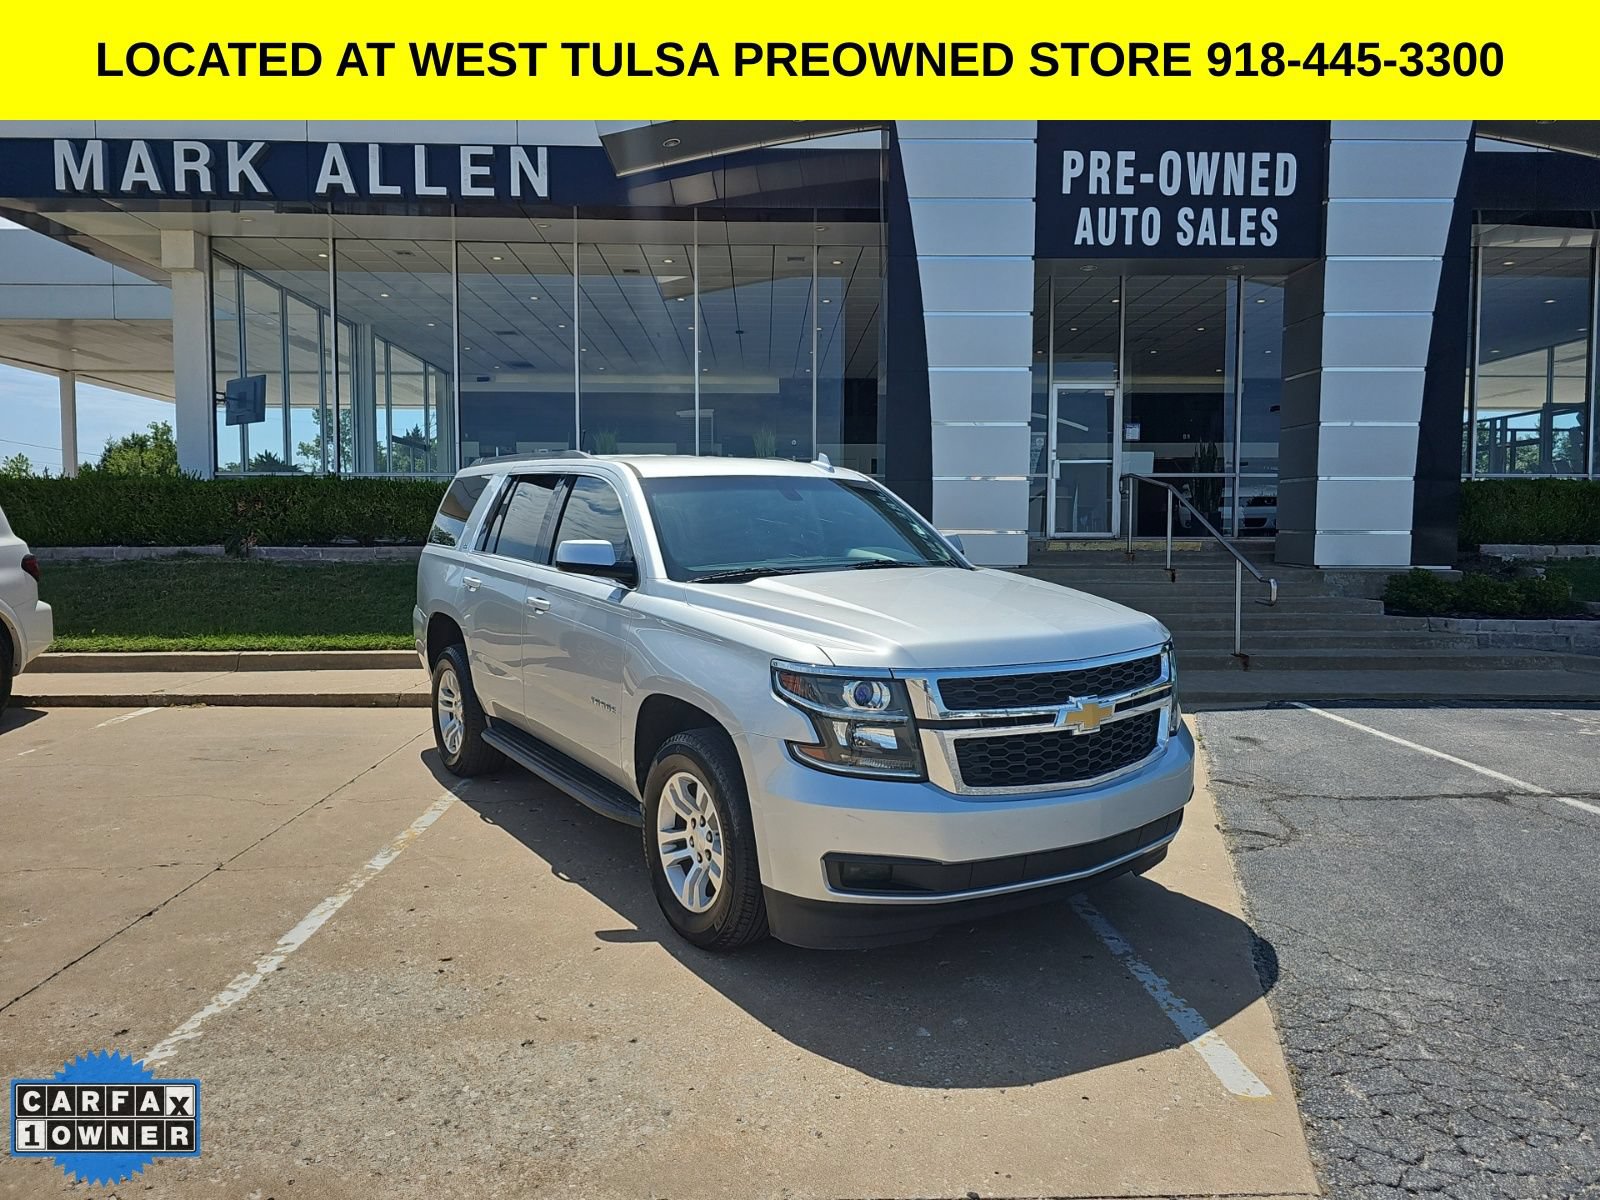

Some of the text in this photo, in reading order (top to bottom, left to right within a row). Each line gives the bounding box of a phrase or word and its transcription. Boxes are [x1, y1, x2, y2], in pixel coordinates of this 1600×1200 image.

[53, 139, 550, 198] MARK ALLEN
[1062, 150, 1298, 197] PRE-OWNED
[1074, 206, 1279, 247] AUTO SALES
